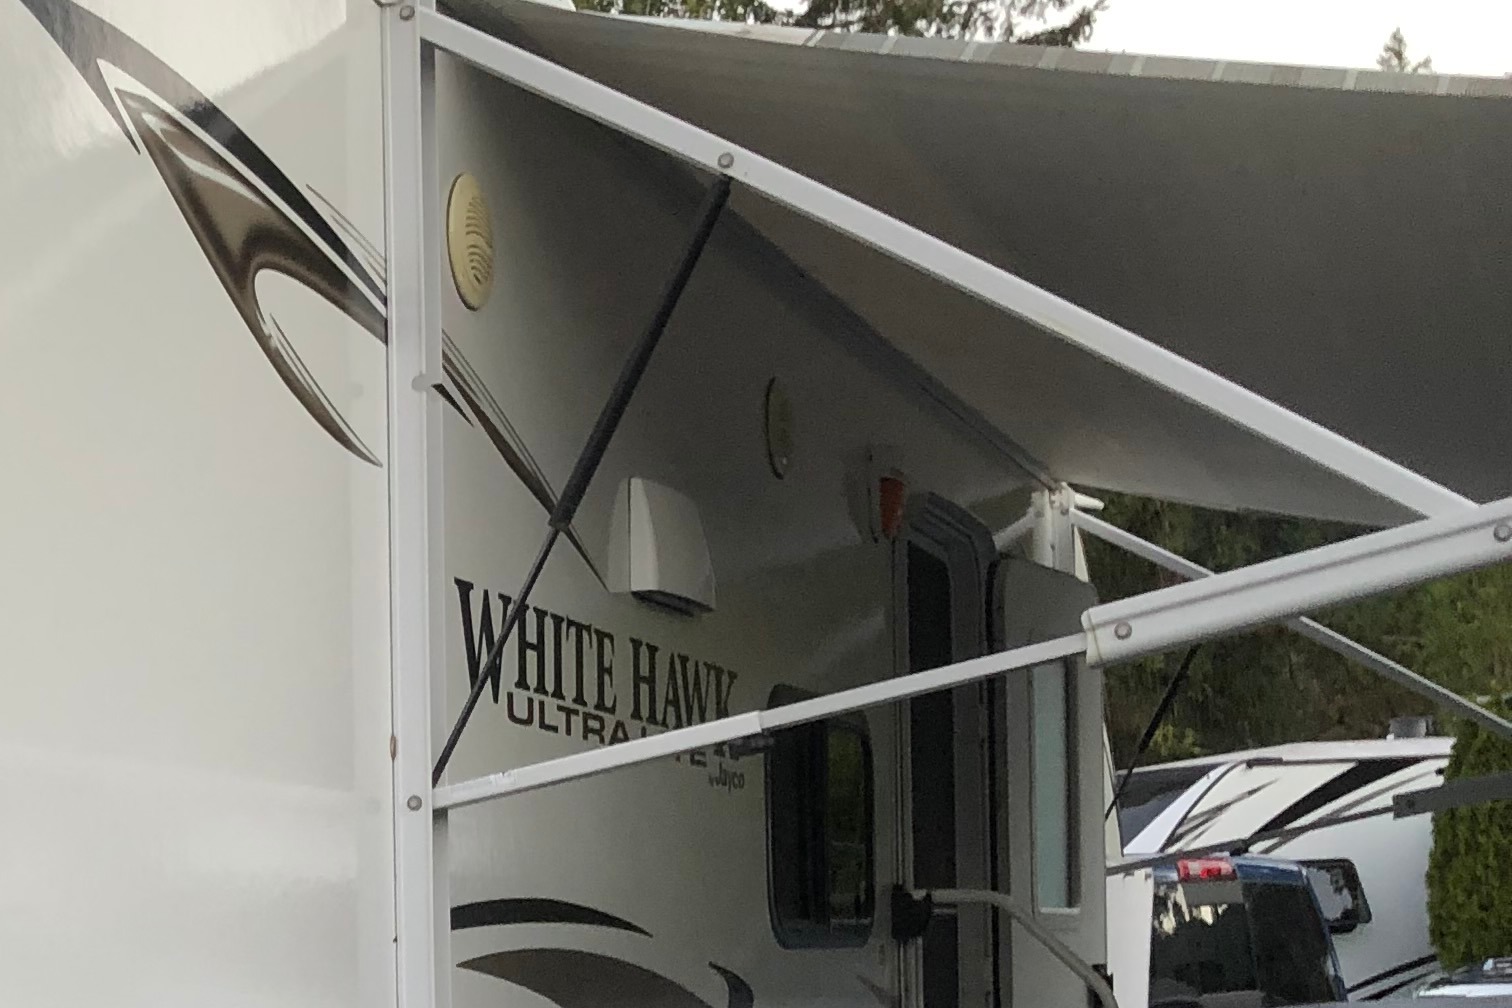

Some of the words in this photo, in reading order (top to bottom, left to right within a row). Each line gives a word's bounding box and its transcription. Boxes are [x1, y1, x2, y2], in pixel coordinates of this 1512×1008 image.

[454, 577, 617, 715] WHITE
[630, 637, 740, 759] HAWK
[506, 691, 630, 746] ULTRA
